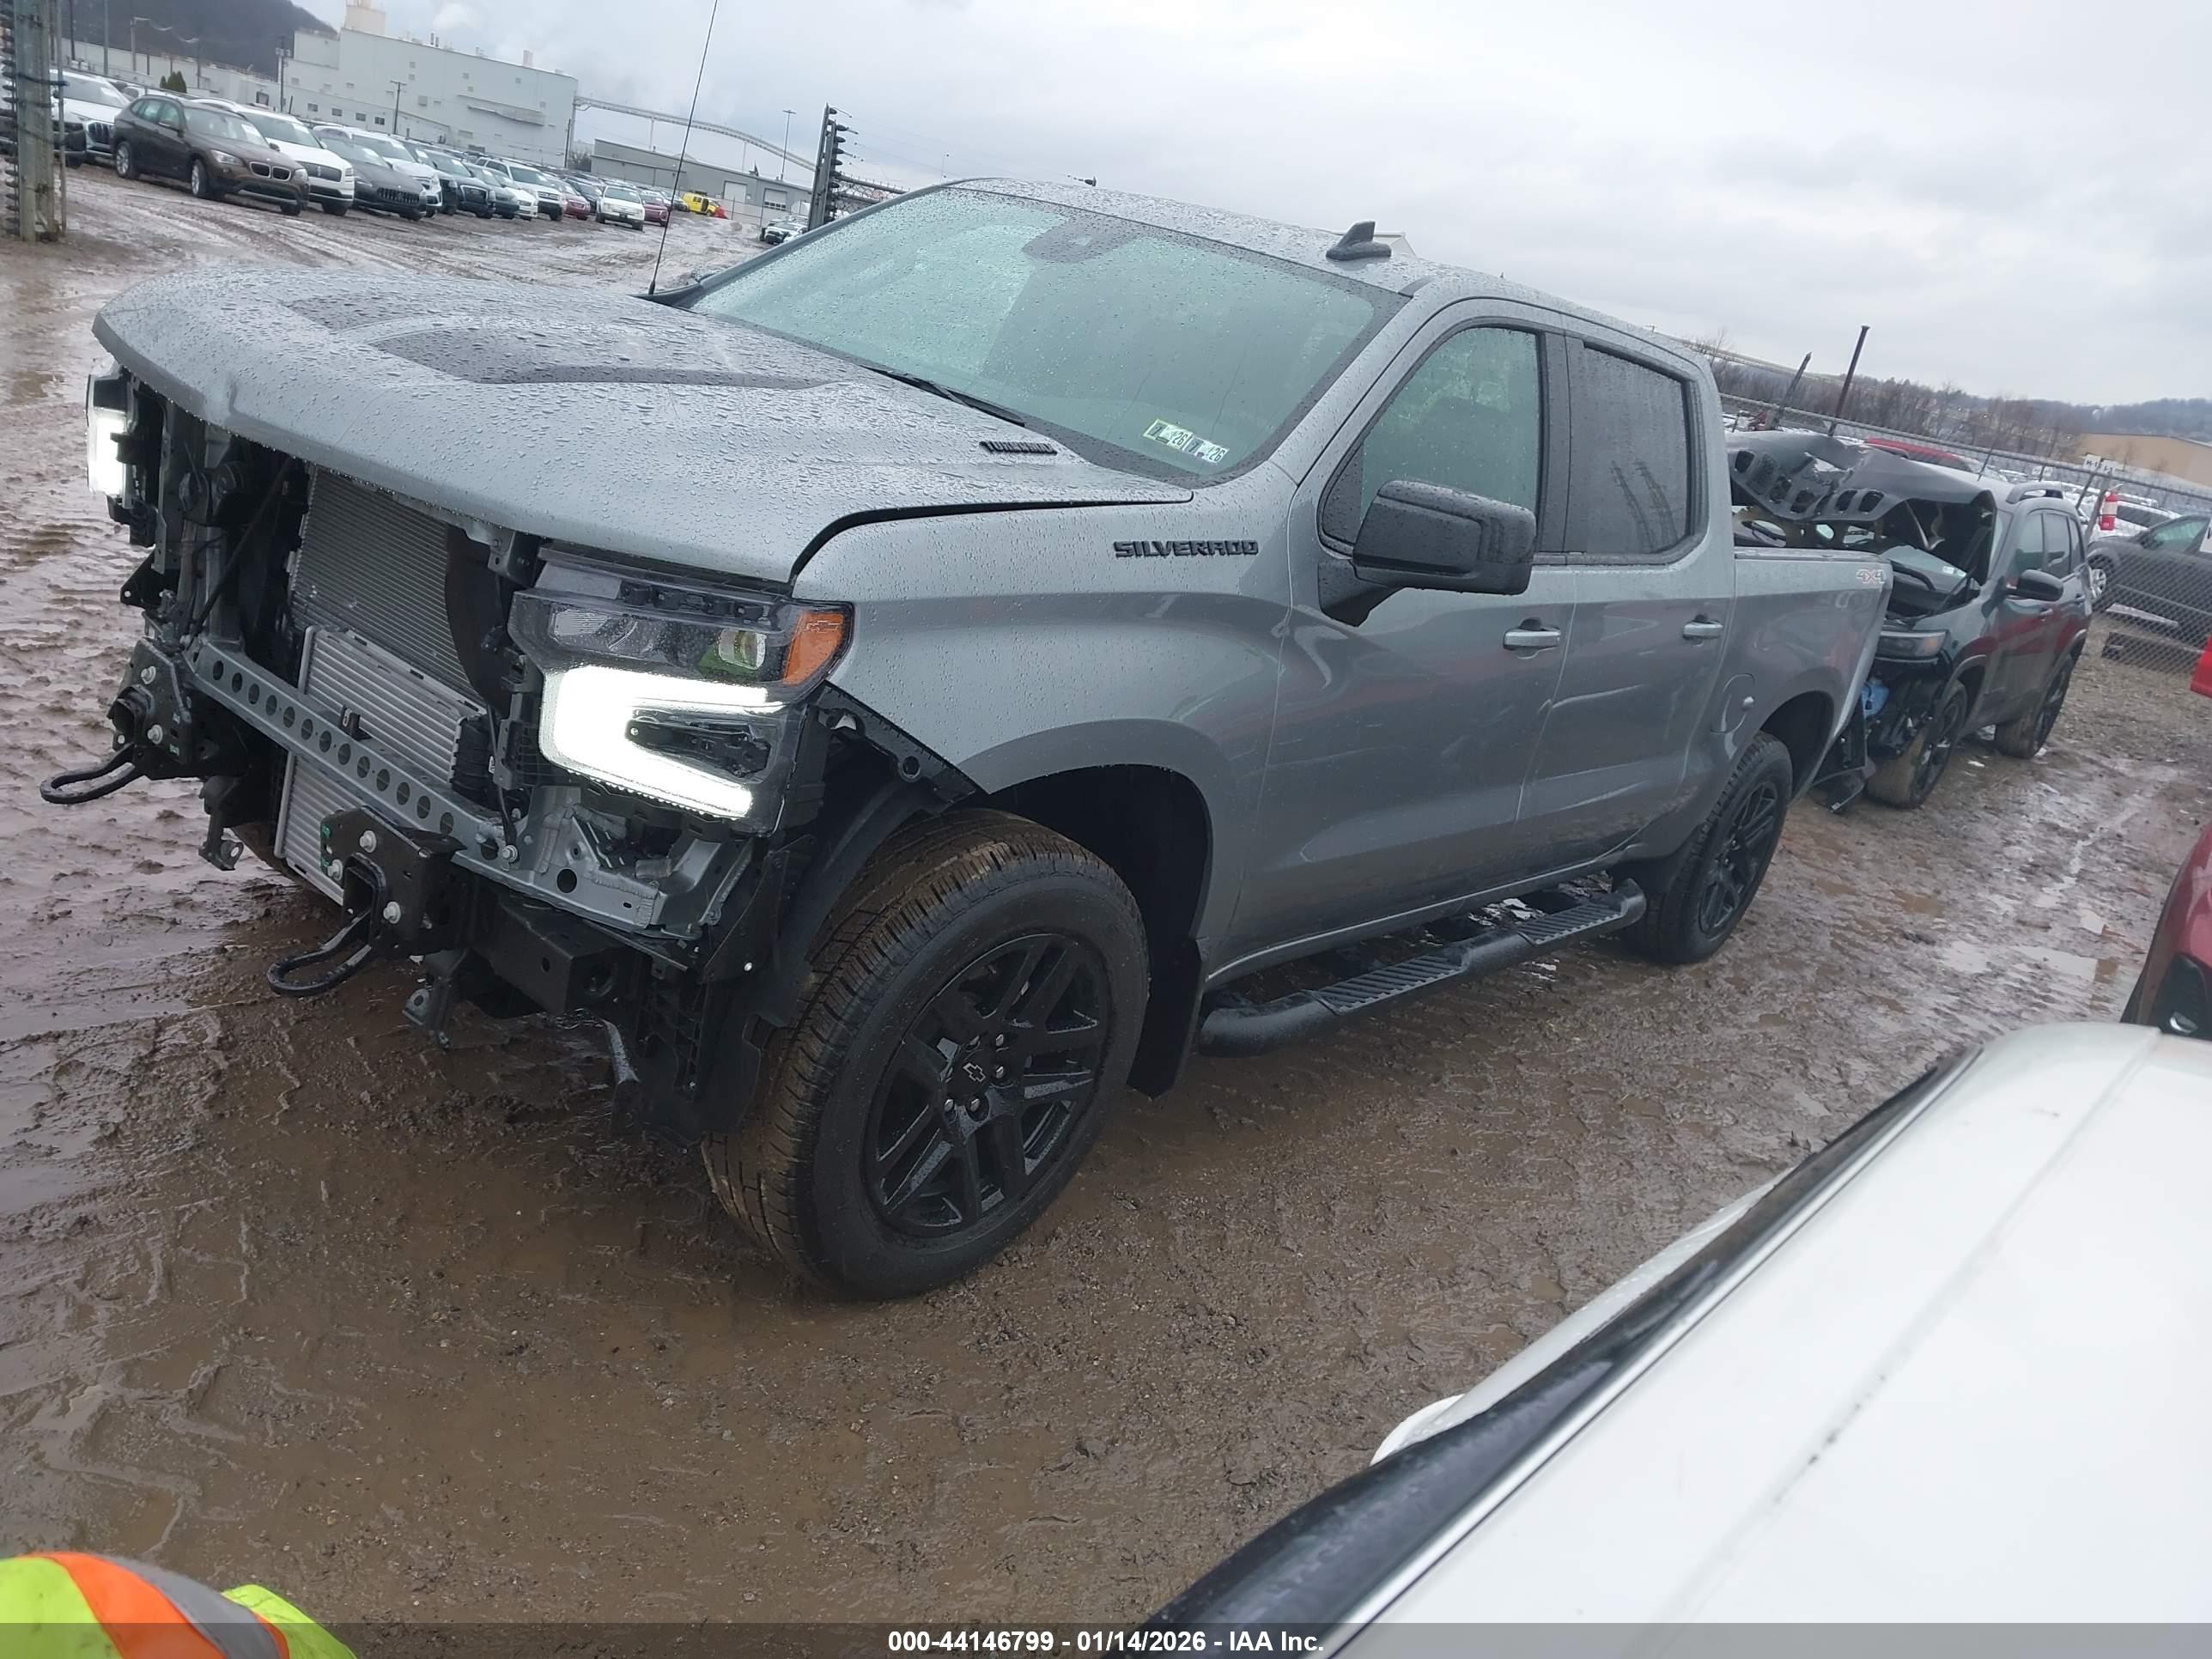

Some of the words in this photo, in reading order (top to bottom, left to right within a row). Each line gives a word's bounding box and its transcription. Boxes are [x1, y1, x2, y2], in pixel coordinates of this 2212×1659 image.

[1171, 431, 1188, 446] 26
[1208, 447, 1226, 462] 26
[1113, 540, 1259, 558] SILVERADO
